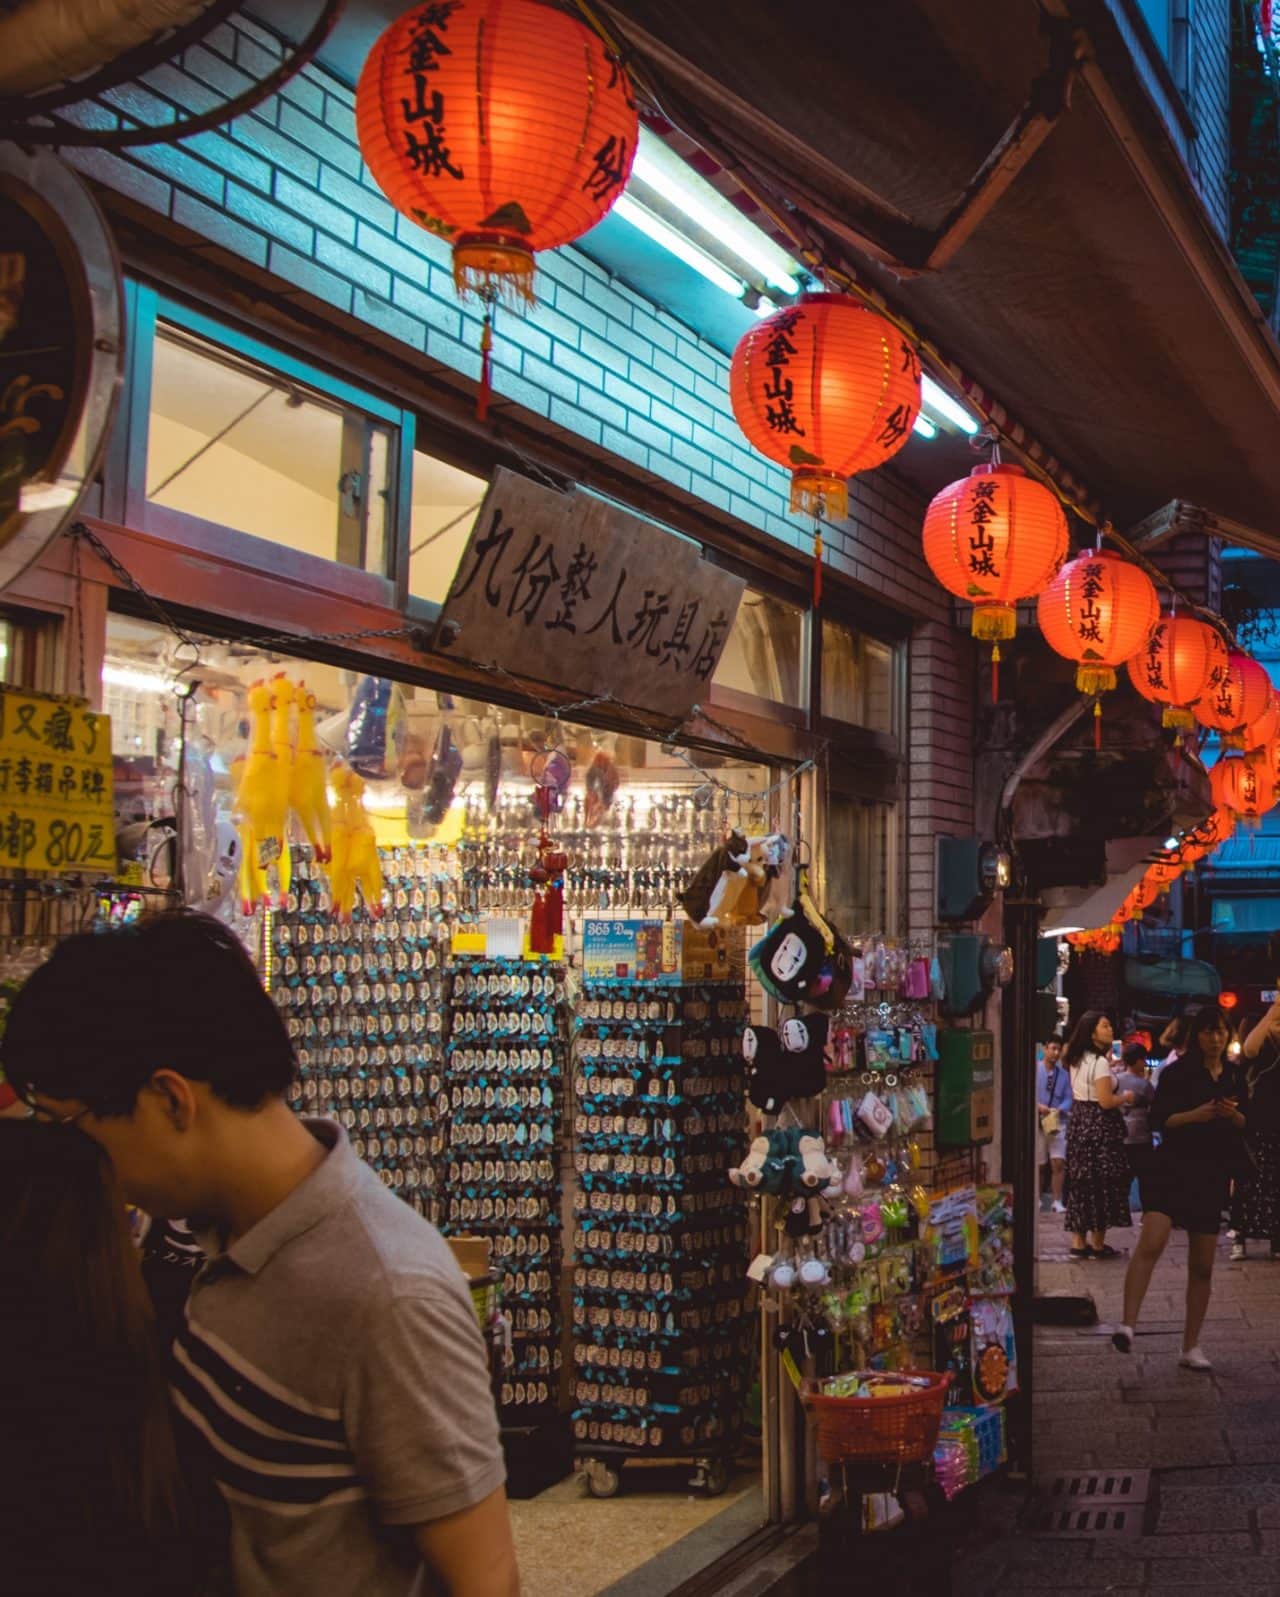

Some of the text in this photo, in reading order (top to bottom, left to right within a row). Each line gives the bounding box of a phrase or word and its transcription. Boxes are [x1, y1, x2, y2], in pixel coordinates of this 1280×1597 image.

[453, 509, 729, 680] 九份整人玩具店
[0, 699, 99, 754] 又瘋了
[0, 811, 112, 866] 都80元
